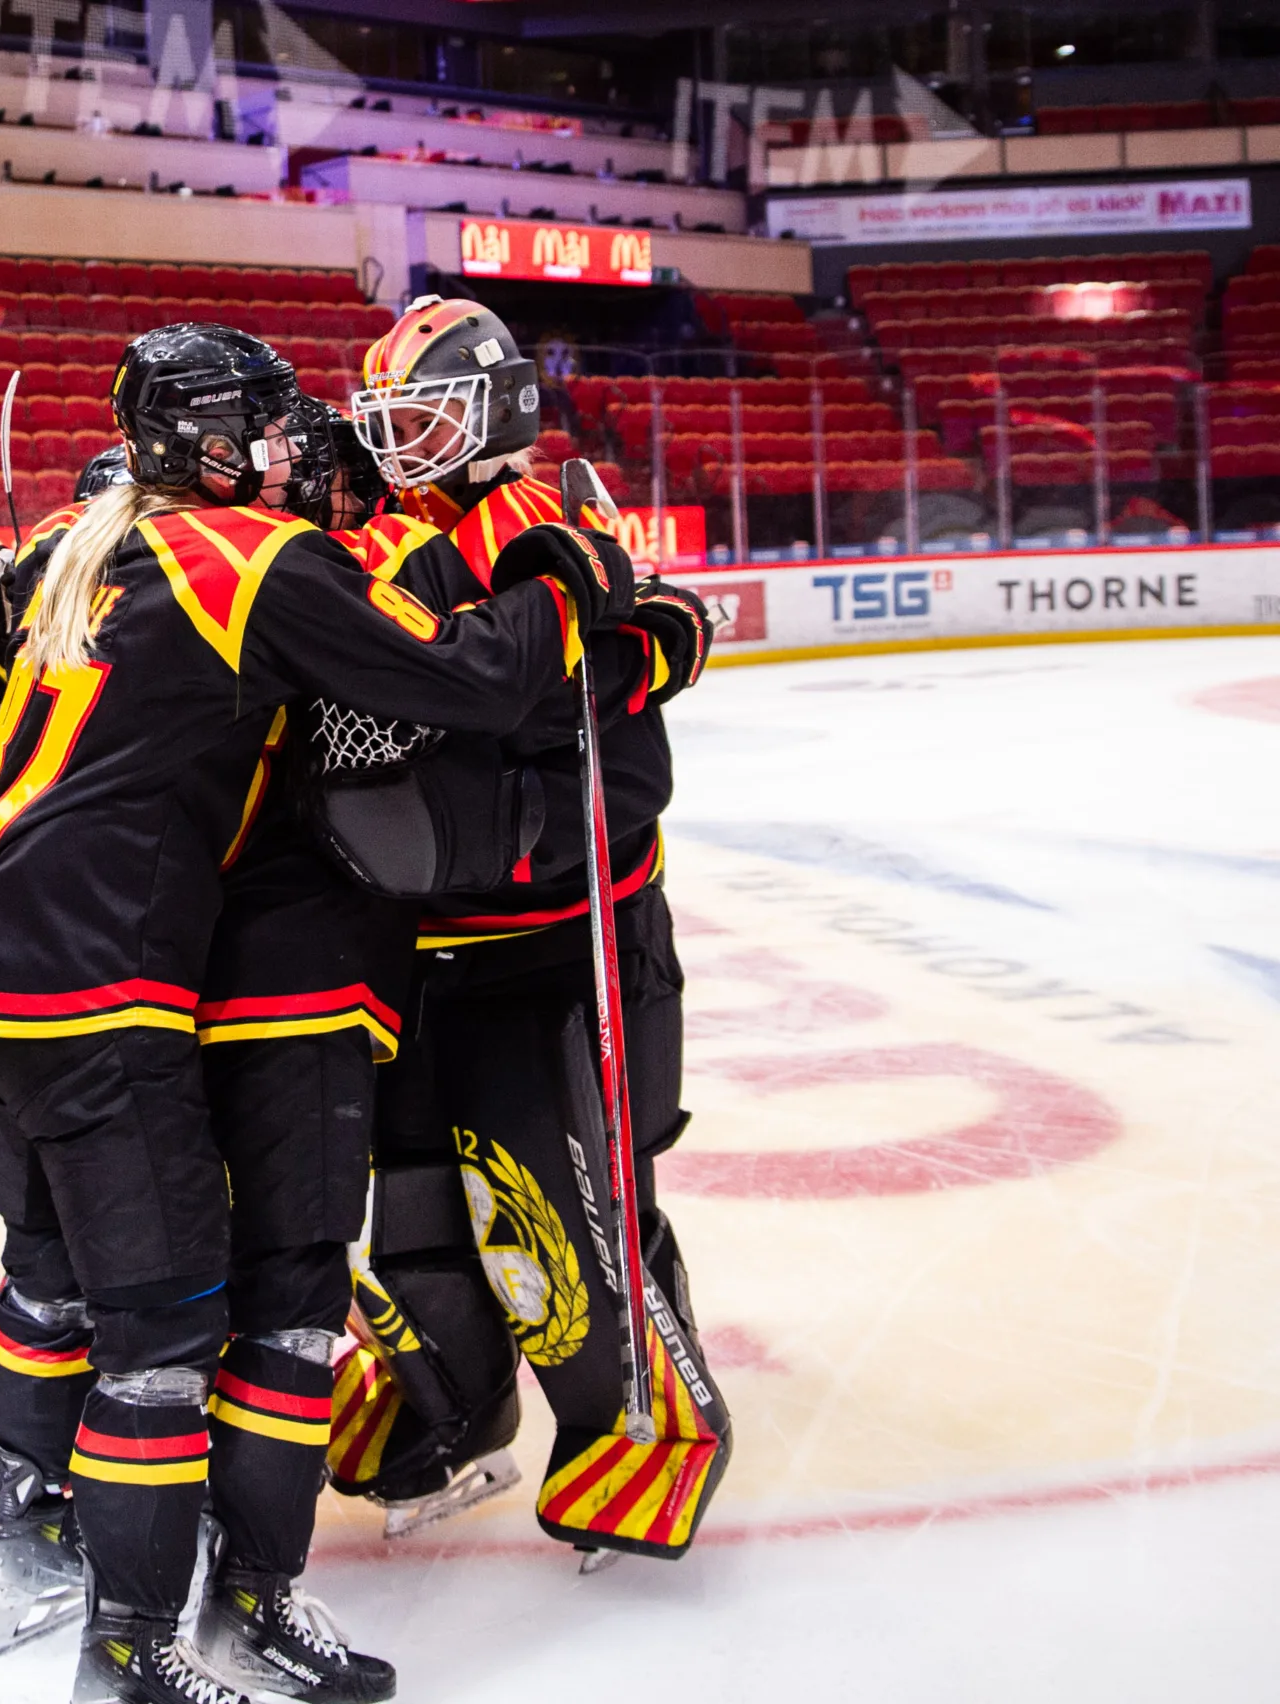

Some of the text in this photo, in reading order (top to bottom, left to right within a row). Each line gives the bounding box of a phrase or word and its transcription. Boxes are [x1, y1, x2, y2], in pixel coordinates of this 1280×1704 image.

[670, 77, 881, 187] ITEM
[532, 227, 590, 268] Mål
[190, 390, 242, 407] BAUER
[200, 455, 242, 478] BAUER
[368, 577, 442, 644] 8
[813, 571, 930, 621] TSG
[998, 574, 1198, 613] THORNE
[567, 1132, 619, 1293] BAUER
[644, 1284, 713, 1407] BAUER
[262, 1648, 322, 1686] BAUER
